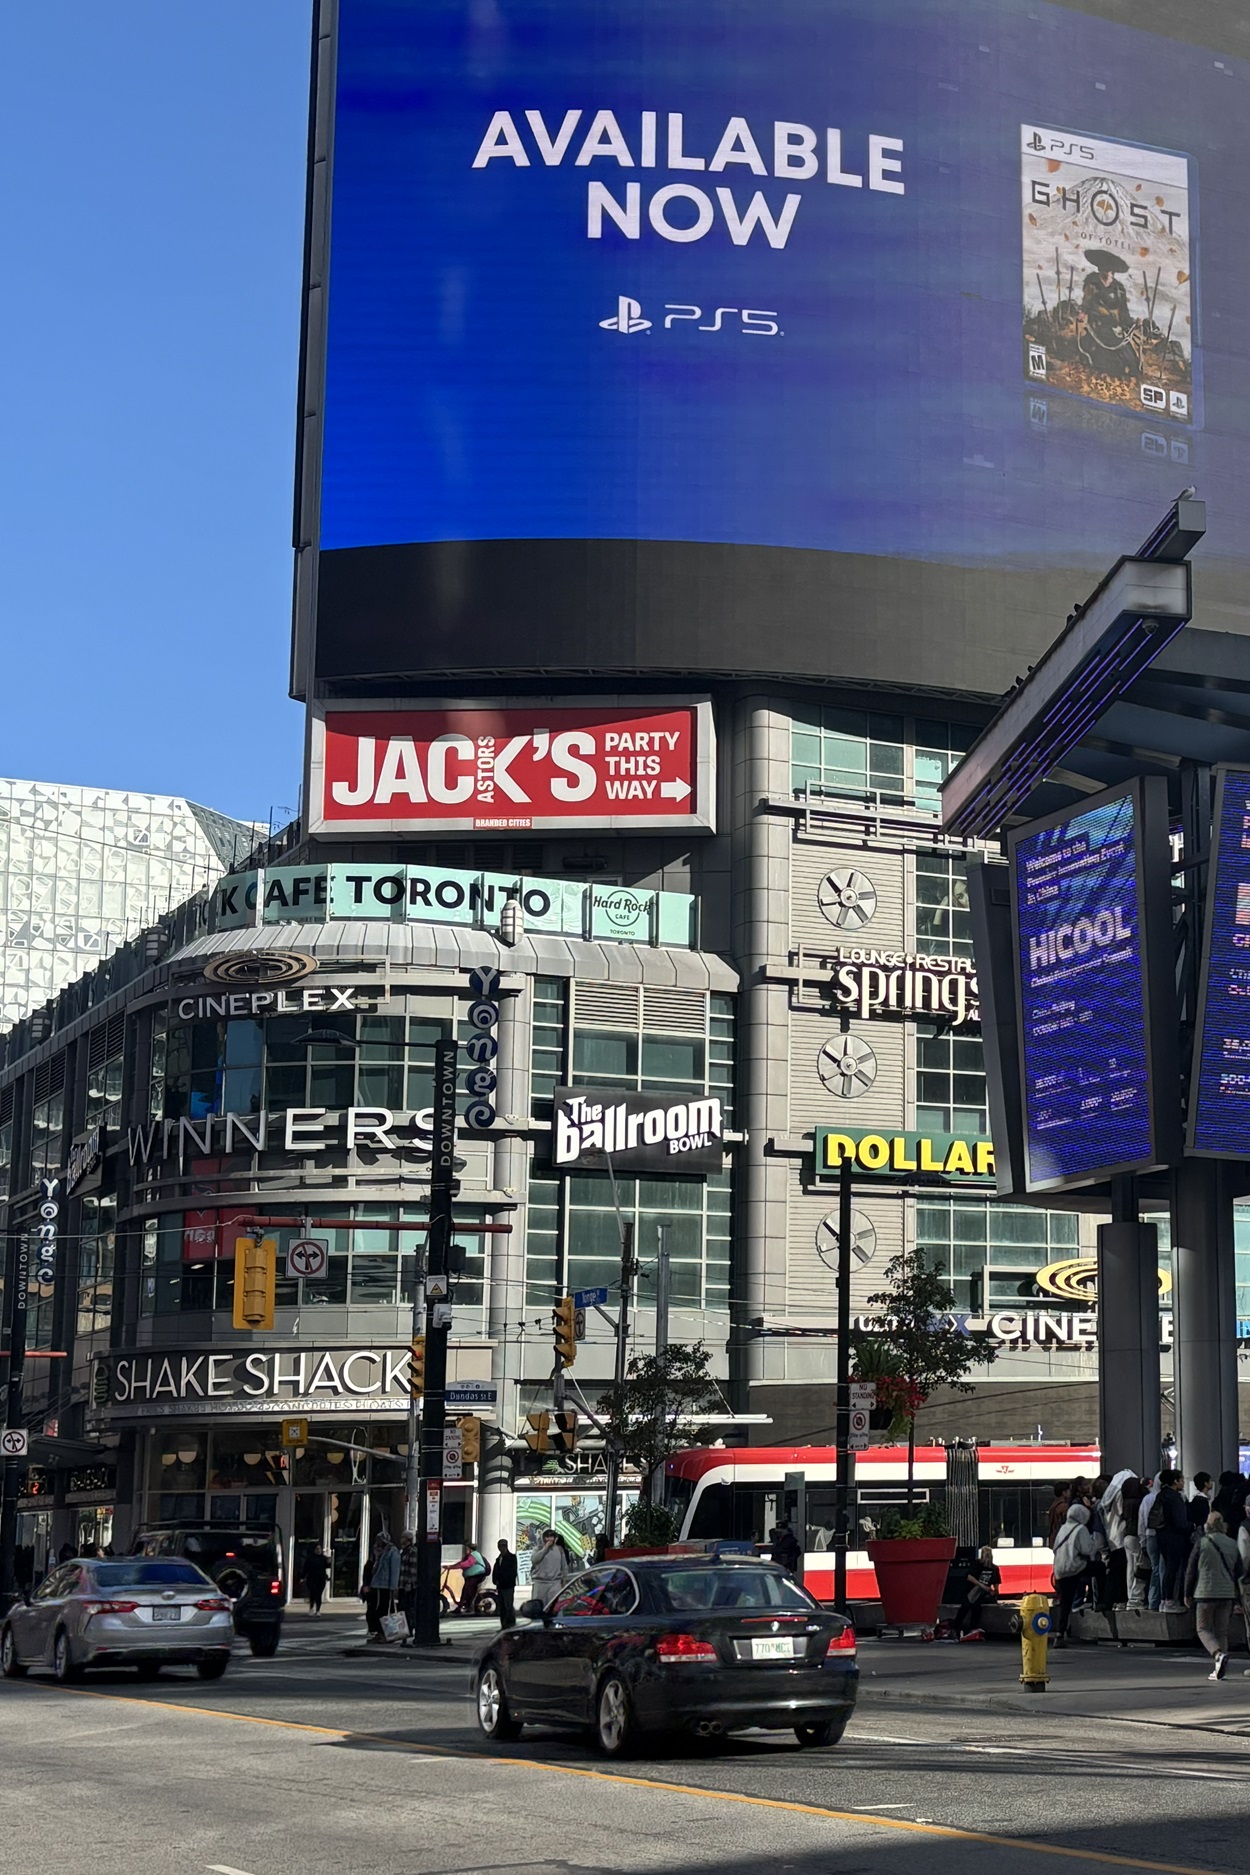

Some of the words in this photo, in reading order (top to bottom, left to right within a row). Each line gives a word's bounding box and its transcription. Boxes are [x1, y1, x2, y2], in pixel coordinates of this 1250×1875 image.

[471, 110, 905, 195] AVAILABLE
[1050, 139, 1095, 160] PS5
[587, 181, 801, 249] NOW
[1031, 180, 1181, 236] GHOST
[664, 304, 779, 336] PS5
[605, 731, 680, 752] PARTY
[476, 735, 495, 804] ASTORS
[605, 755, 661, 776] THIS
[605, 779, 658, 800] WAY
[245, 876, 335, 911] CAFE
[346, 875, 551, 917] TORONTO
[593, 896, 620, 910] Hard
[623, 898, 652, 917] Rock
[610, 928, 636, 936] TORONTO
[1029, 906, 1132, 970] HICOOL
[839, 946, 905, 967] LOUNGE
[178, 987, 356, 1020] CINEPLEX
[467, 968, 498, 1126] Yonge
[440, 1051, 455, 1167] DOWNTOWN
[566, 1096, 603, 1124] The
[128, 1106, 434, 1167] WINNERS
[669, 1132, 713, 1154] BOWL
[36, 1178, 59, 1285] Yonge
[18, 1233, 29, 1309] DOWNTOWN
[115, 1354, 234, 1401] SHAKE
[242, 1351, 413, 1396] SHACK
[450, 1391, 479, 1400] Dundas
